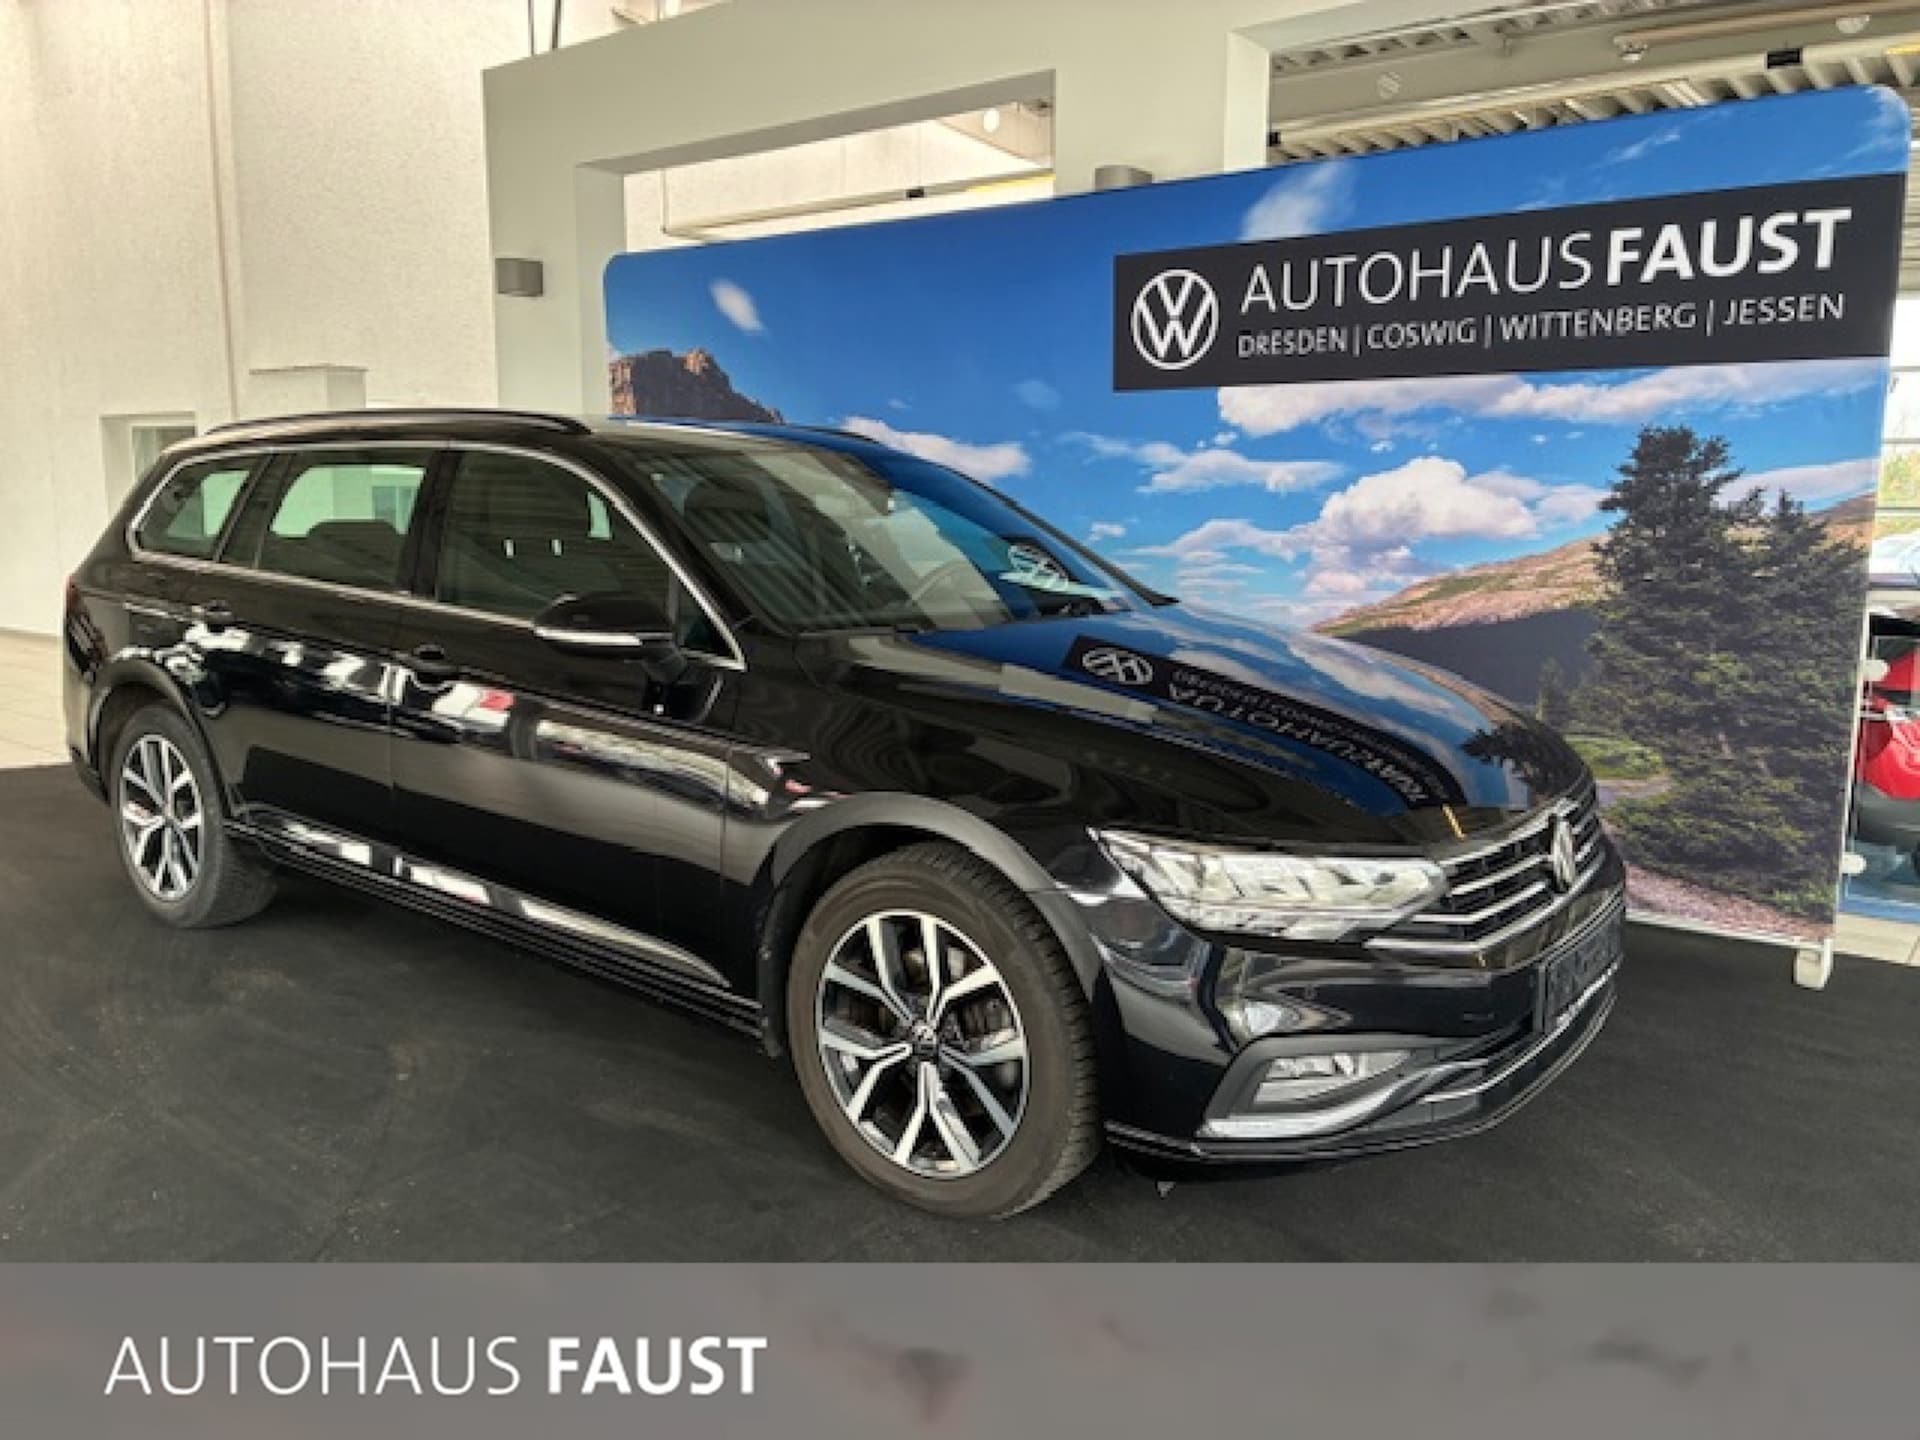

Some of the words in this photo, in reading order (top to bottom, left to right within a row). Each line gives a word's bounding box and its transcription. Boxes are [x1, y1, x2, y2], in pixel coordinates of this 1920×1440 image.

[1240, 231, 1593, 313] AUTOHAUS
[1607, 208, 1851, 286] FAUST
[1237, 328, 1347, 358] DRESDEN
[1367, 317, 1476, 350] COSWIG
[1499, 302, 1698, 341] WITTENBERG
[1723, 293, 1844, 326] JESSEN
